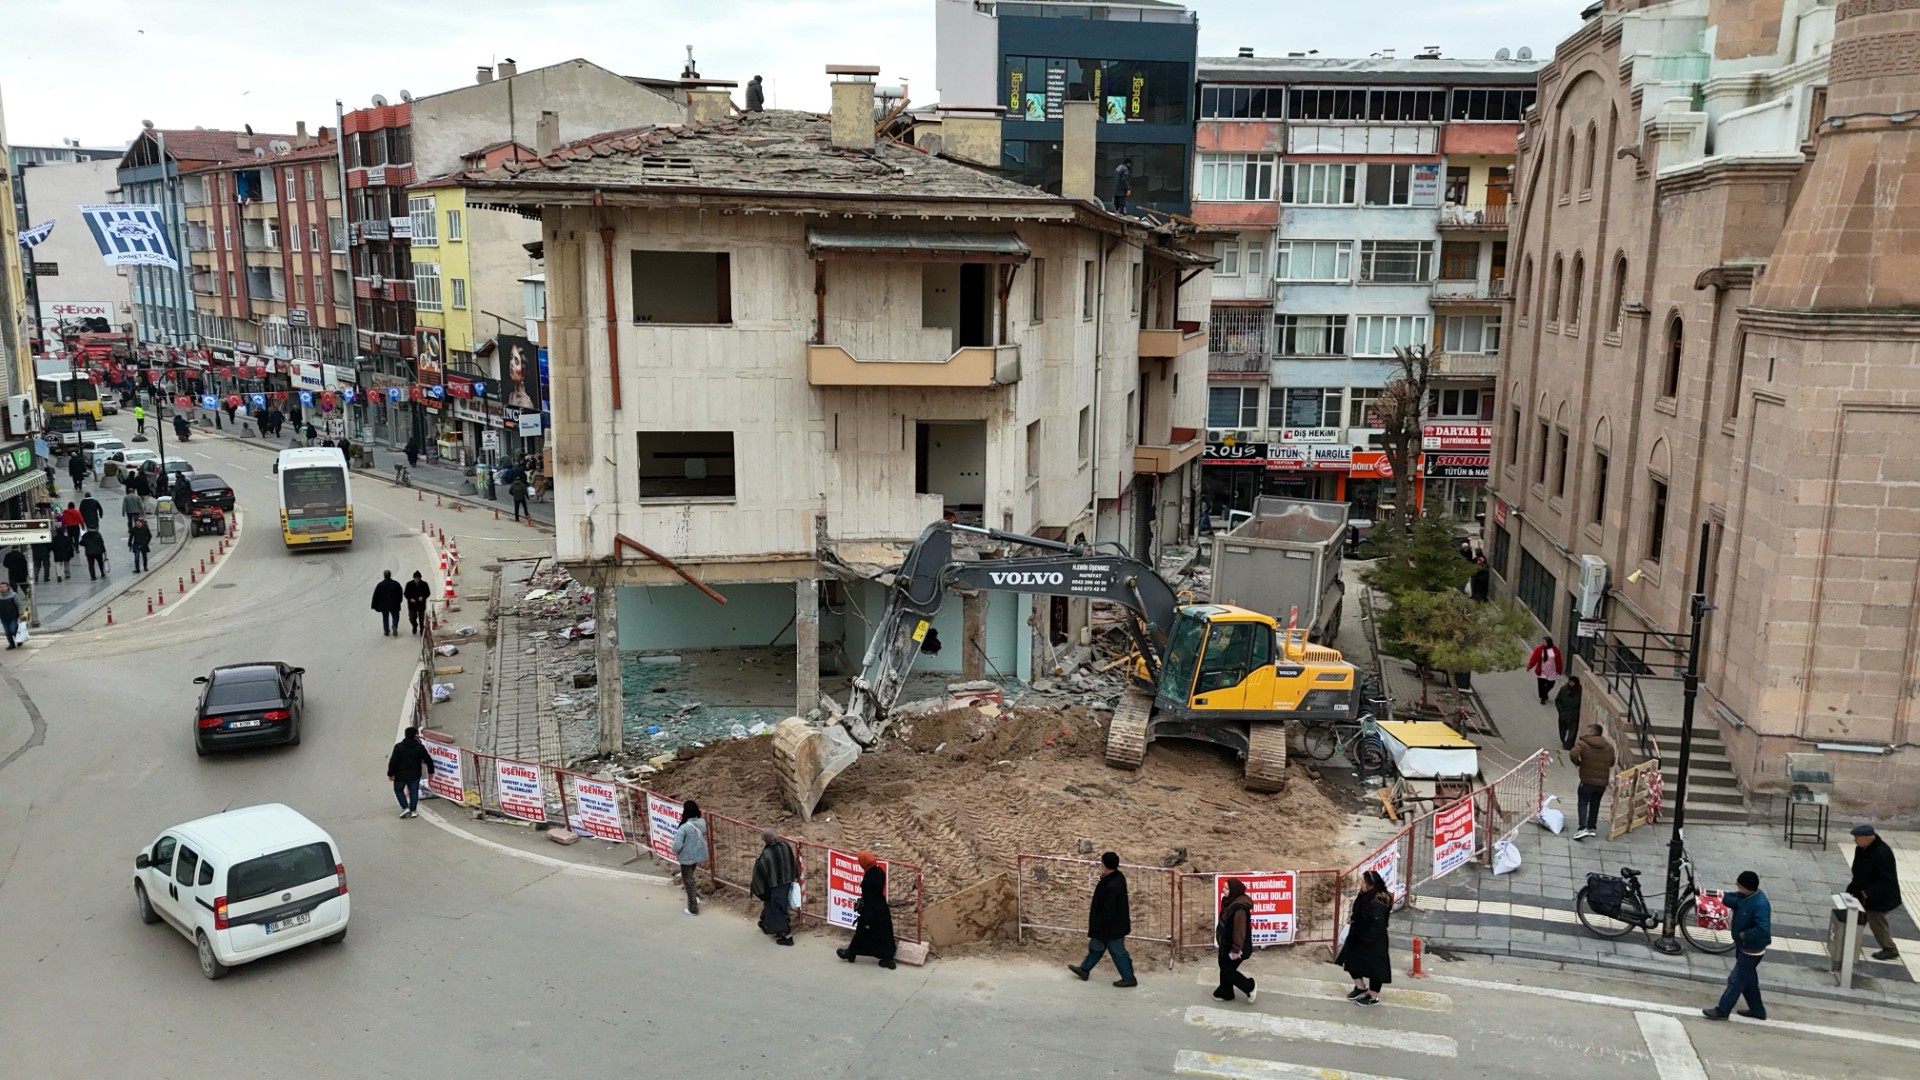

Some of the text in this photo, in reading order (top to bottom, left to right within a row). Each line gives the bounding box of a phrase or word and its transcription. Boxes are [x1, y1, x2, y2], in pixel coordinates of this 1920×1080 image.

[301, 376, 322, 386] PROFİL
[1435, 427, 1478, 436] DARTAR
[1445, 467, 1466, 476] TÜTÜN
[989, 571, 1064, 585] VOLVO
[1270, 891, 1292, 900] DOLAYI
[1253, 902, 1276, 912] DİLERİZ
[270, 922, 279, 931] 06
[297, 914, 307, 922] 697
[1251, 922, 1288, 930] NMEZ
